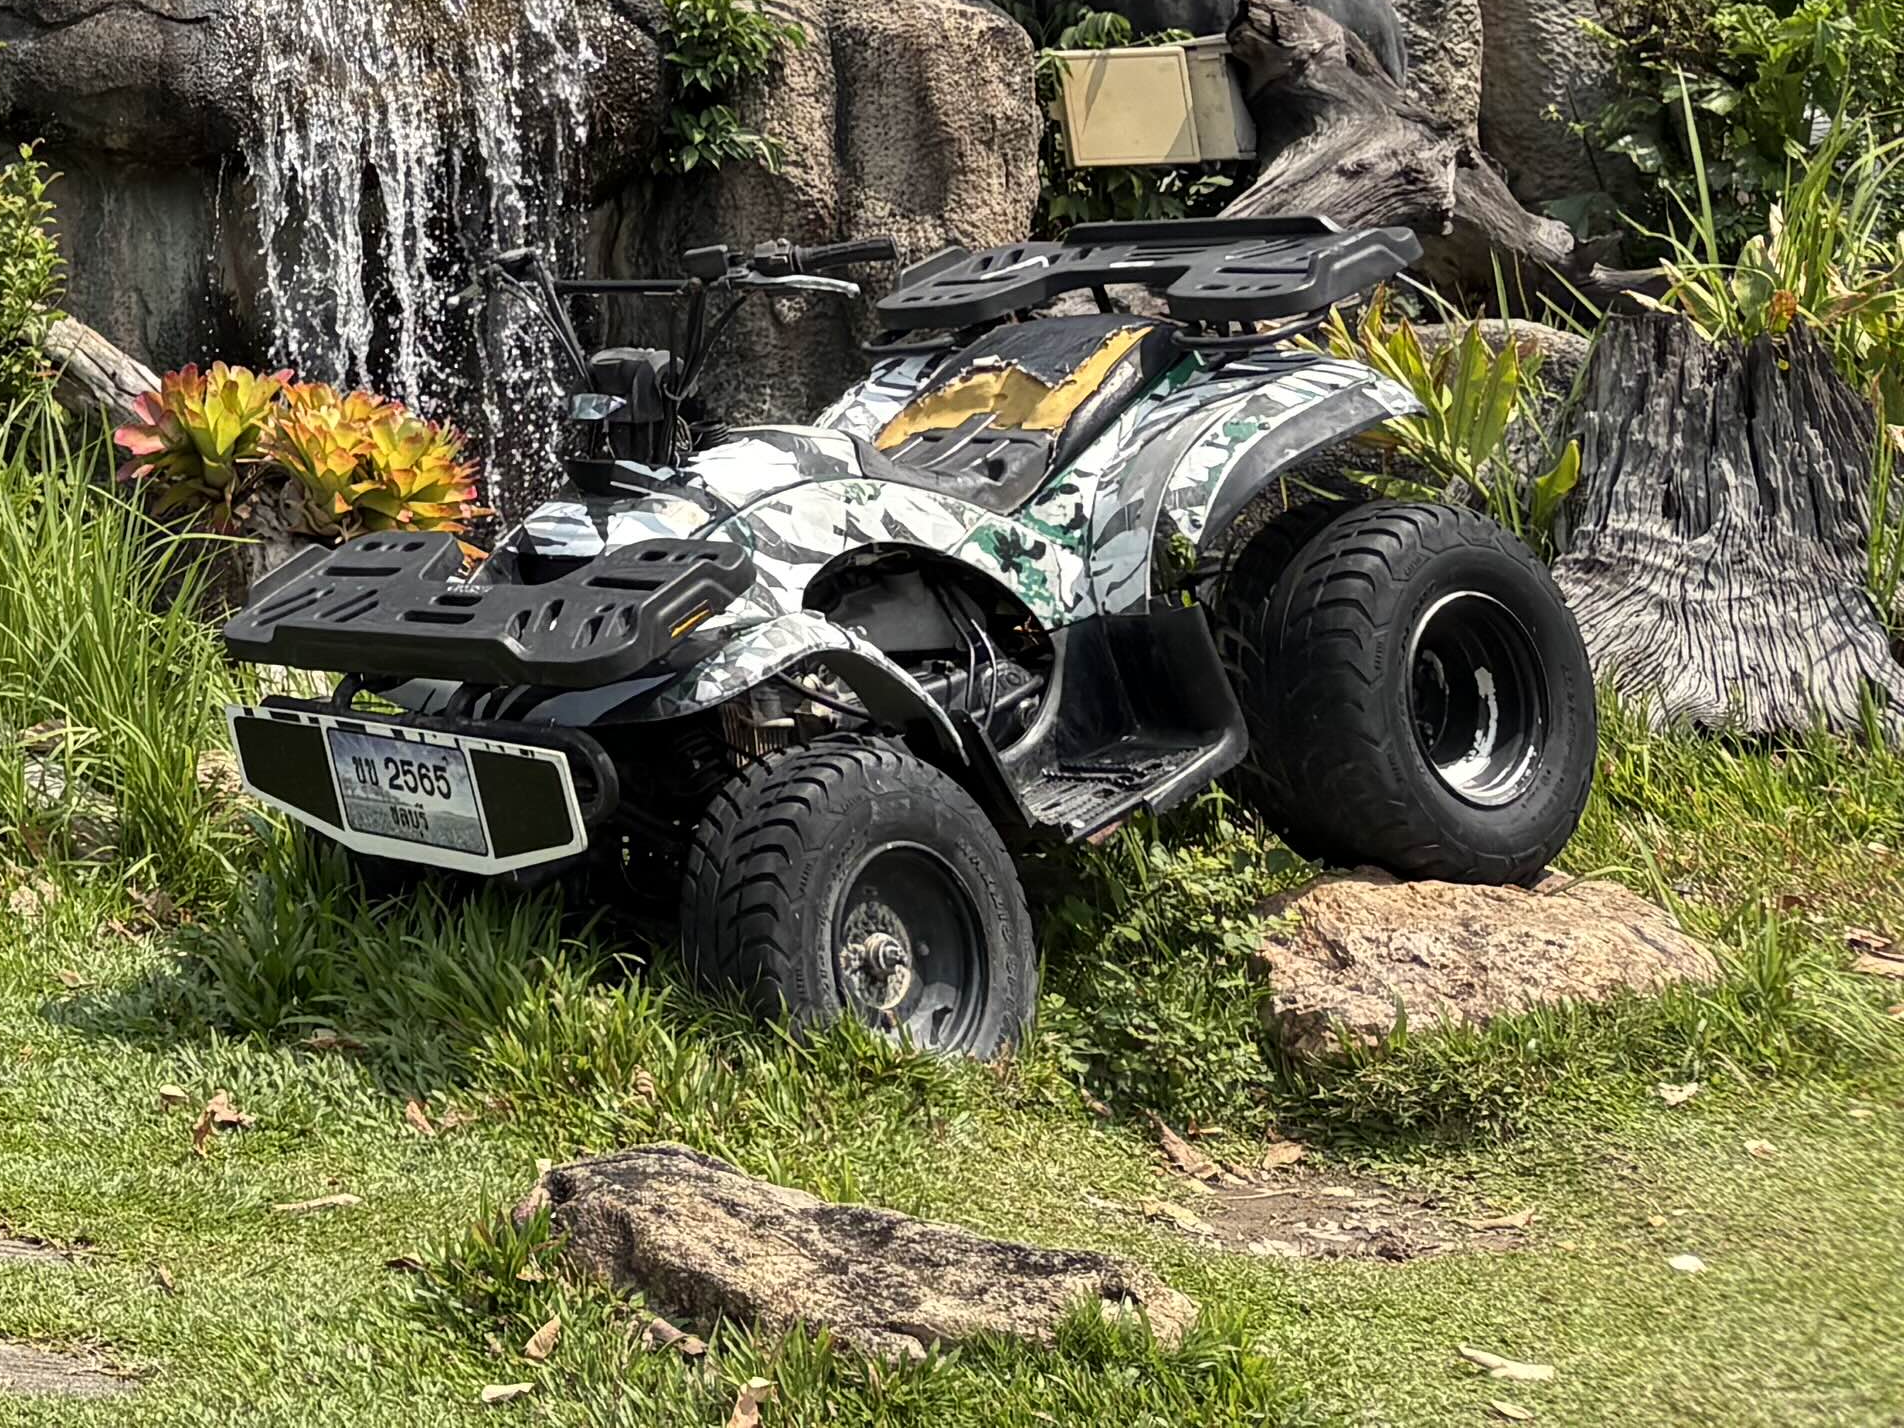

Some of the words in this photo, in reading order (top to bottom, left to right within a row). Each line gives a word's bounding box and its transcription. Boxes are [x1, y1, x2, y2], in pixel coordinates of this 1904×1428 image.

[384, 756, 452, 801] 2565
[390, 802, 430, 839] ชลบุรี
